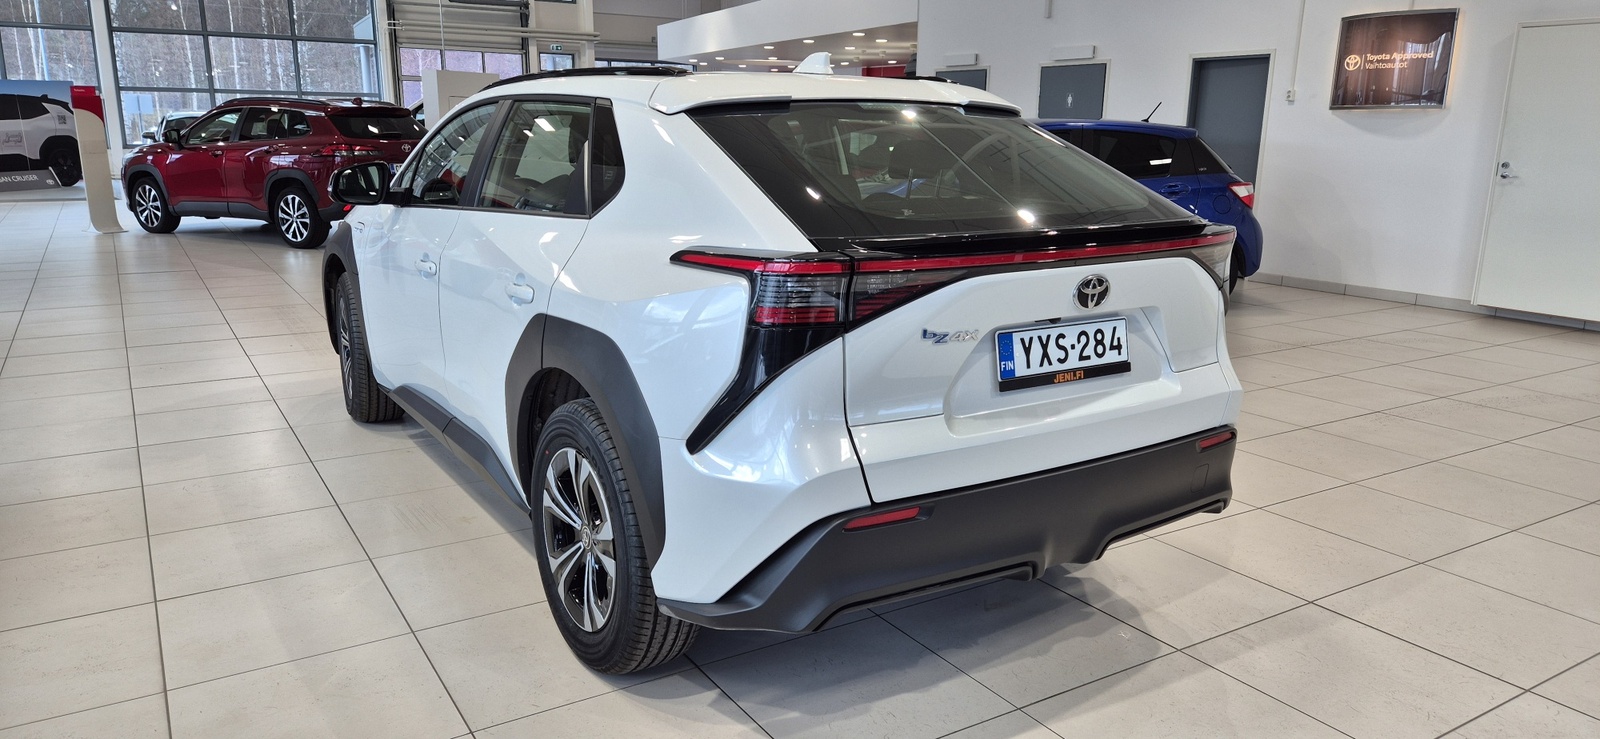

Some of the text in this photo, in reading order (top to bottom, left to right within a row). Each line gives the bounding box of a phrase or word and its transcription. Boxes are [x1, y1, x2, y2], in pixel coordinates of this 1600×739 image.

[1366, 51, 1434, 62] Toyota Approved
[1365, 62, 1408, 70] Vaihtoautot
[11, 174, 39, 182] CRUISER
[1001, 360, 1014, 372] FIN
[1053, 370, 1084, 384] JENI.FI
